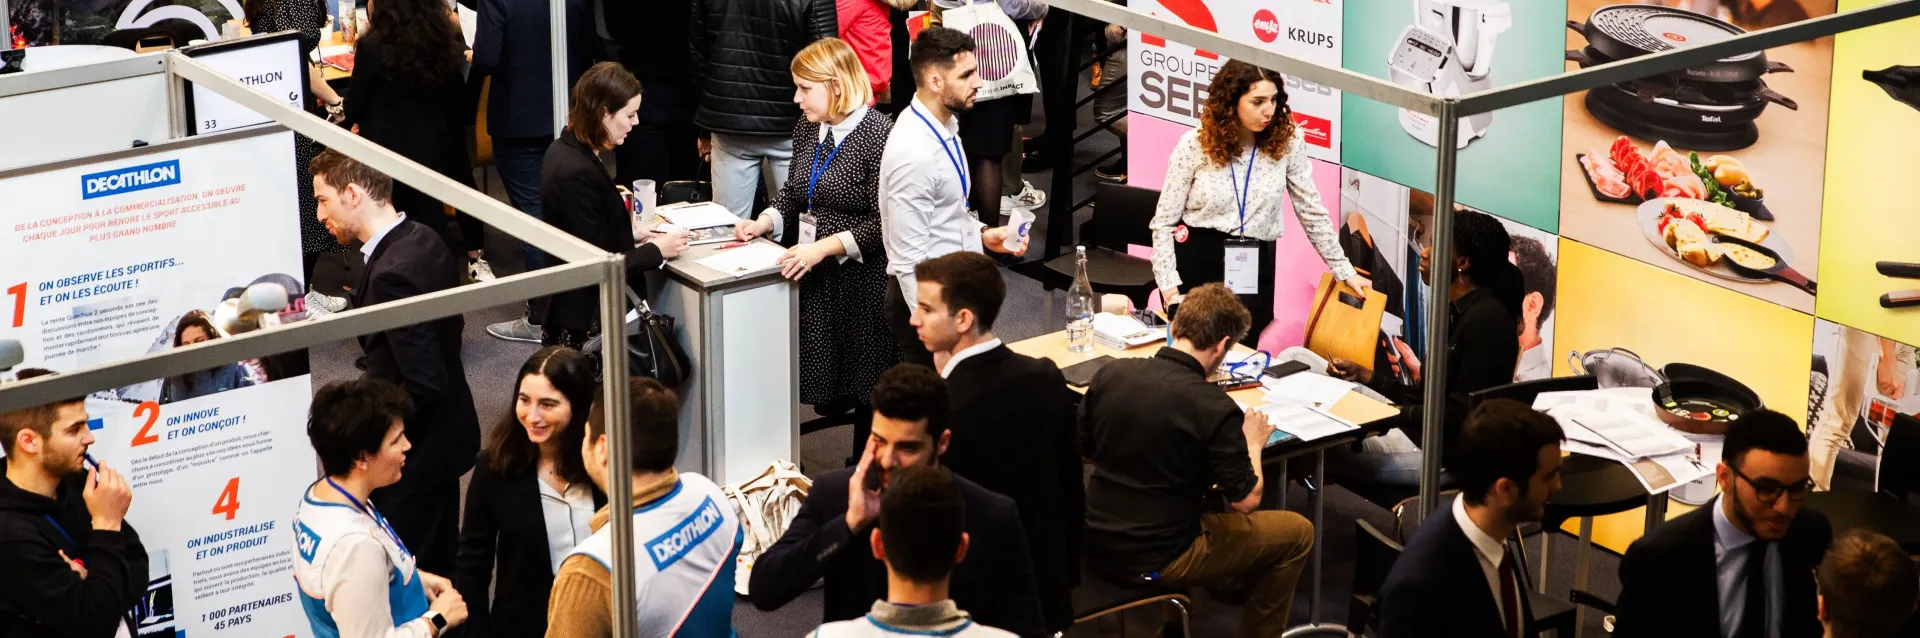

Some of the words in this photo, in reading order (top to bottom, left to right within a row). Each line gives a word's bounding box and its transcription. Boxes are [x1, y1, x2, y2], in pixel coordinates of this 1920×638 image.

[1288, 27, 1334, 49] KRUPS
[1140, 50, 1219, 81] GROUPE
[1000, 83, 1024, 91] IMPACT
[205, 120, 217, 130] 33
[1701, 115, 1722, 123] Tefal
[87, 165, 175, 194] DECATHLON
[15, 223, 26, 232] DE
[28, 221, 38, 230] LA
[40, 211, 93, 228] CONCEPTION
[102, 207, 112, 217] LA
[202, 189, 214, 199] ON
[216, 184, 247, 196] OEUVRE
[23, 230, 57, 243] CHAQUE
[60, 225, 81, 237] JOUR
[83, 221, 106, 233] POUR
[108, 215, 140, 229] RENDRE
[141, 213, 151, 222] LE
[152, 208, 179, 220] SPORT
[180, 199, 227, 214] ACCESSIBLE
[229, 197, 241, 206] AU
[89, 232, 111, 243] PLUS
[113, 227, 141, 239] GRAND
[39, 278, 54, 292] ON
[56, 271, 103, 288] OBSERVE
[106, 267, 124, 280] LES
[126, 257, 185, 275] SPORTIFS...
[7, 282, 28, 328] 1
[40, 294, 53, 307] ET
[55, 291, 70, 303] ON
[72, 287, 91, 300] LES
[94, 280, 133, 296] ÉCOUTE
[135, 279, 139, 288] !
[50, 316, 65, 324] tente
[100, 305, 124, 315] seconds
[148, 298, 158, 306] des
[42, 323, 77, 335] discussions
[44, 343, 64, 352] monter
[65, 336, 98, 348] rapidement
[110, 330, 132, 338] bivouac
[64, 330, 75, 338] des
[76, 344, 98, 354] marche
[131, 400, 161, 447] 2
[166, 415, 181, 427] ON
[183, 407, 220, 423] INNOVE
[167, 430, 179, 440] ET
[182, 426, 196, 437] ON
[198, 416, 241, 432] CONÇOIT
[242, 415, 246, 424] !
[179, 443, 209, 455] conception
[212, 476, 240, 521] 4
[187, 538, 201, 549] ON
[204, 520, 276, 545] INDUSTRIALISE
[652, 501, 720, 563] DECATHLON
[196, 550, 209, 561] ET
[210, 546, 224, 557] ON
[226, 535, 269, 553] PRODUIT
[193, 568, 213, 577] Partout
[244, 554, 275, 566] partenaires
[202, 614, 206, 622] 1
[210, 609, 226, 621] 000
[228, 593, 293, 616] PARTENAIRES
[214, 620, 225, 631] 45
[228, 614, 252, 628] PAYS
